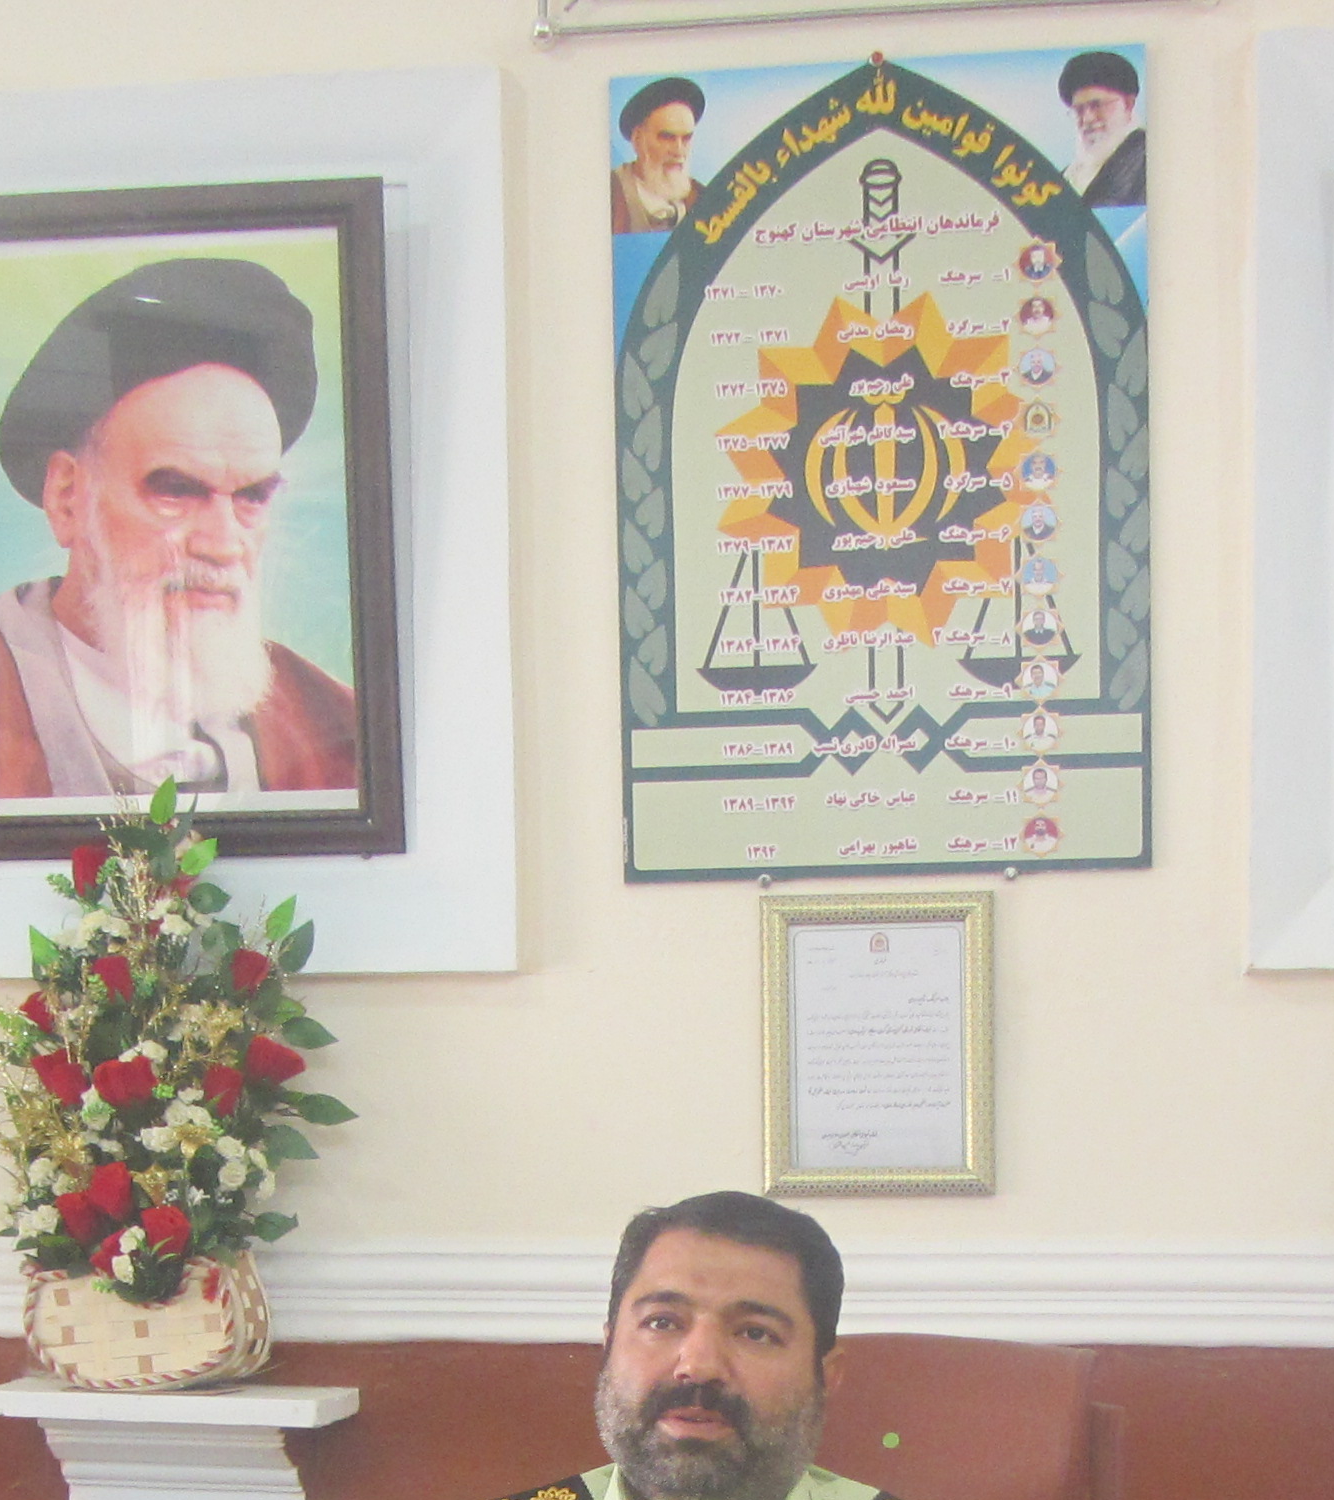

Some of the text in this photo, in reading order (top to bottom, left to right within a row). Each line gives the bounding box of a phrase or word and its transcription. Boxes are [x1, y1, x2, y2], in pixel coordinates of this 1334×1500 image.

[776, 97, 852, 167] شهداء
[901, 99, 996, 157] قوامین
[694, 159, 779, 245] بالقسط
[755, 211, 1000, 243] فرماندهان انتظامی شهرستان کهنوج
[888, 273, 909, 287] رضا
[940, 271, 981, 284] سرهنگ
[839, 324, 868, 340] مدنی
[876, 323, 912, 338] رمضان
[948, 320, 984, 334] سرگرد
[893, 375, 913, 392] علی
[951, 374, 985, 389] سرهنگ
[868, 427, 893, 444] کاظم
[896, 427, 914, 441] سید
[950, 423, 985, 439] سرهنگ
[826, 476, 871, 497] شهبازی
[876, 479, 914, 493] مسعود
[945, 473, 985, 492] سرگرد
[833, 536, 853, 550] پور
[855, 534, 885, 548] رحیم
[890, 529, 914, 546] علی
[940, 527, 984, 544] سرهنگ
[824, 585, 862, 600] مهدوی
[893, 581, 914, 596] سید
[944, 579, 984, 594] سرهنگ
[823, 633, 858, 650] ناظری
[946, 631, 985, 646] سرهنگ
[846, 689, 880, 704] حسینی
[887, 687, 913, 699] احمد
[949, 685, 986, 699] سرهنگ
[814, 738, 838, 753] نسب
[841, 738, 875, 755] قادری
[881, 736, 916, 752] نصراله
[946, 736, 987, 751] سرهنگ
[826, 793, 846, 805] نهاد
[850, 792, 880, 807] خاکی
[887, 791, 916, 806] عباس
[949, 789, 988, 804] سرهنگ
[839, 840, 875, 855] بهرامی
[882, 838, 916, 854] شاهپور
[948, 837, 986, 851] سرهنگ
[747, 845, 777, 860] ۱۳۹۴
